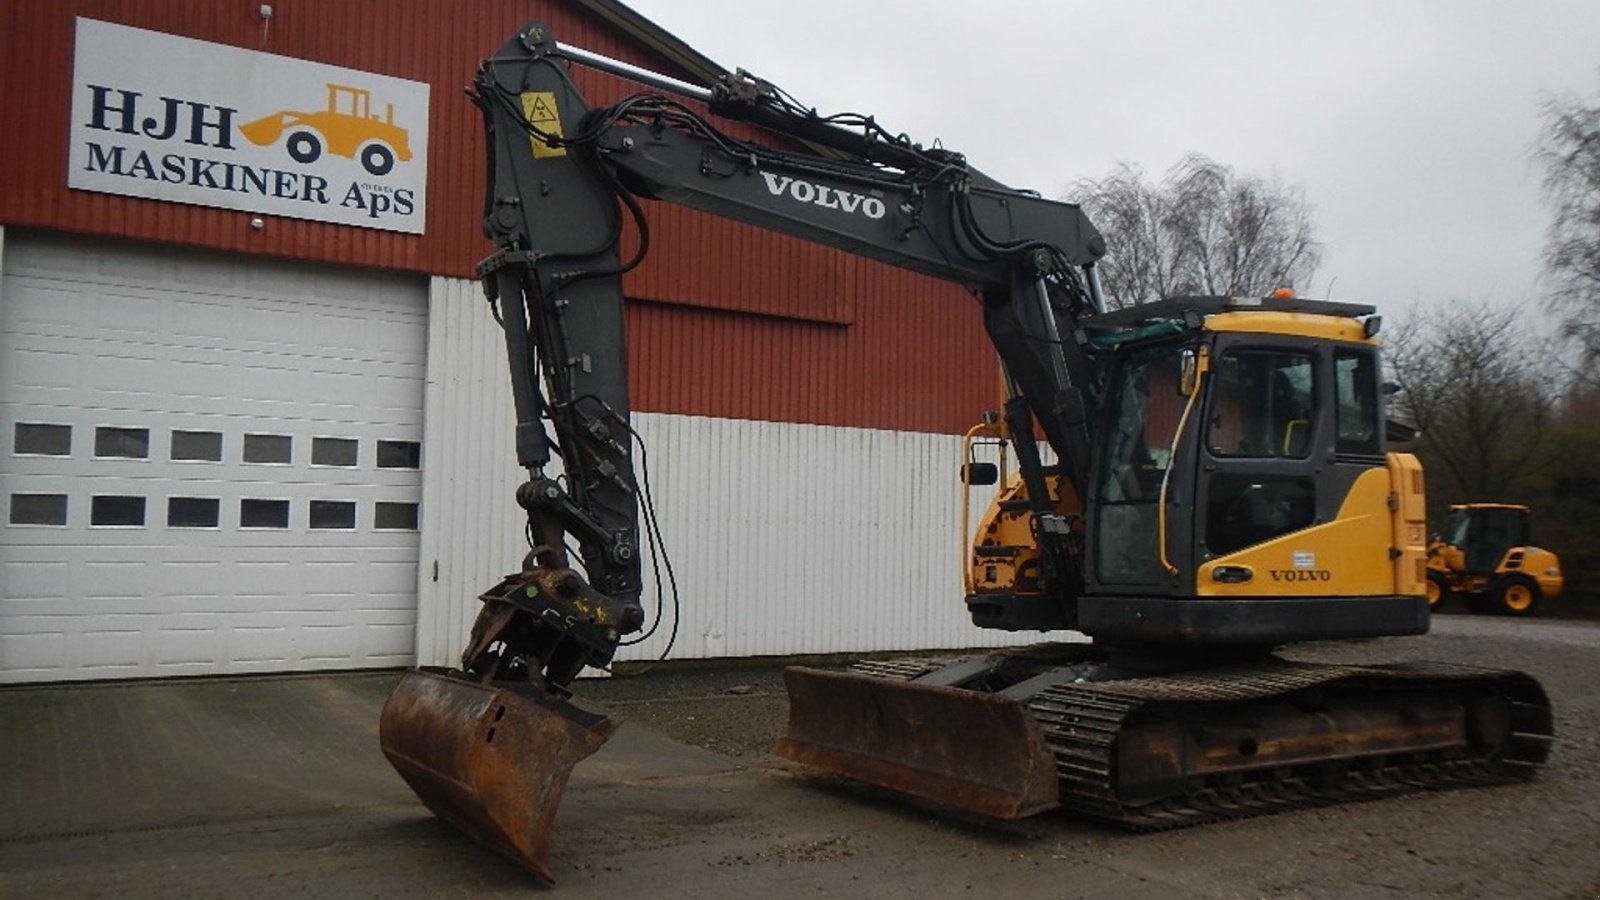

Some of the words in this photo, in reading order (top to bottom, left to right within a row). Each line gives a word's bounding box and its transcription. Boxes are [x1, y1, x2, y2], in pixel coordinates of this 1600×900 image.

[85, 84, 238, 151] HJH
[84, 142, 331, 205] MASKINER
[340, 181, 415, 218] ApS
[759, 170, 886, 219] VOLVO
[1269, 569, 1331, 582] VOLVO
